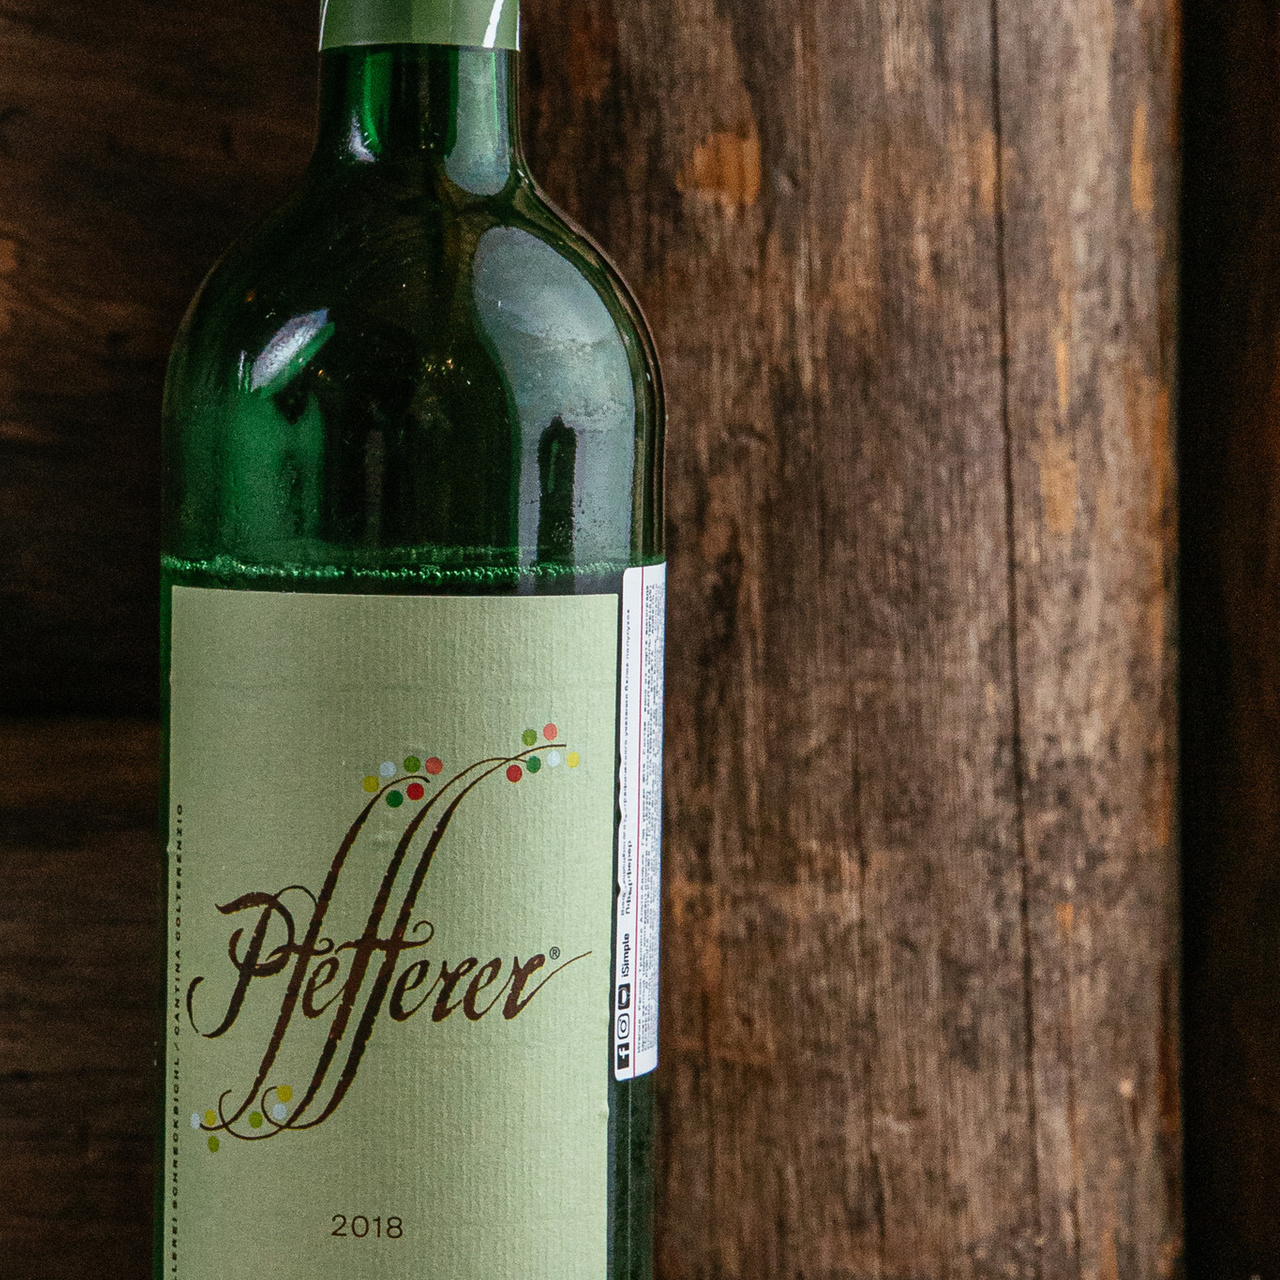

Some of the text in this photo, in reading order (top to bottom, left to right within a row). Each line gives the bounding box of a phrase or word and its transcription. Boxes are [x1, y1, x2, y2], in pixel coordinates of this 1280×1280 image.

[175, 802, 183, 943] COLTERENZIO
[621, 933, 631, 978] iSimple
[331, 1214, 404, 1239] 2018
